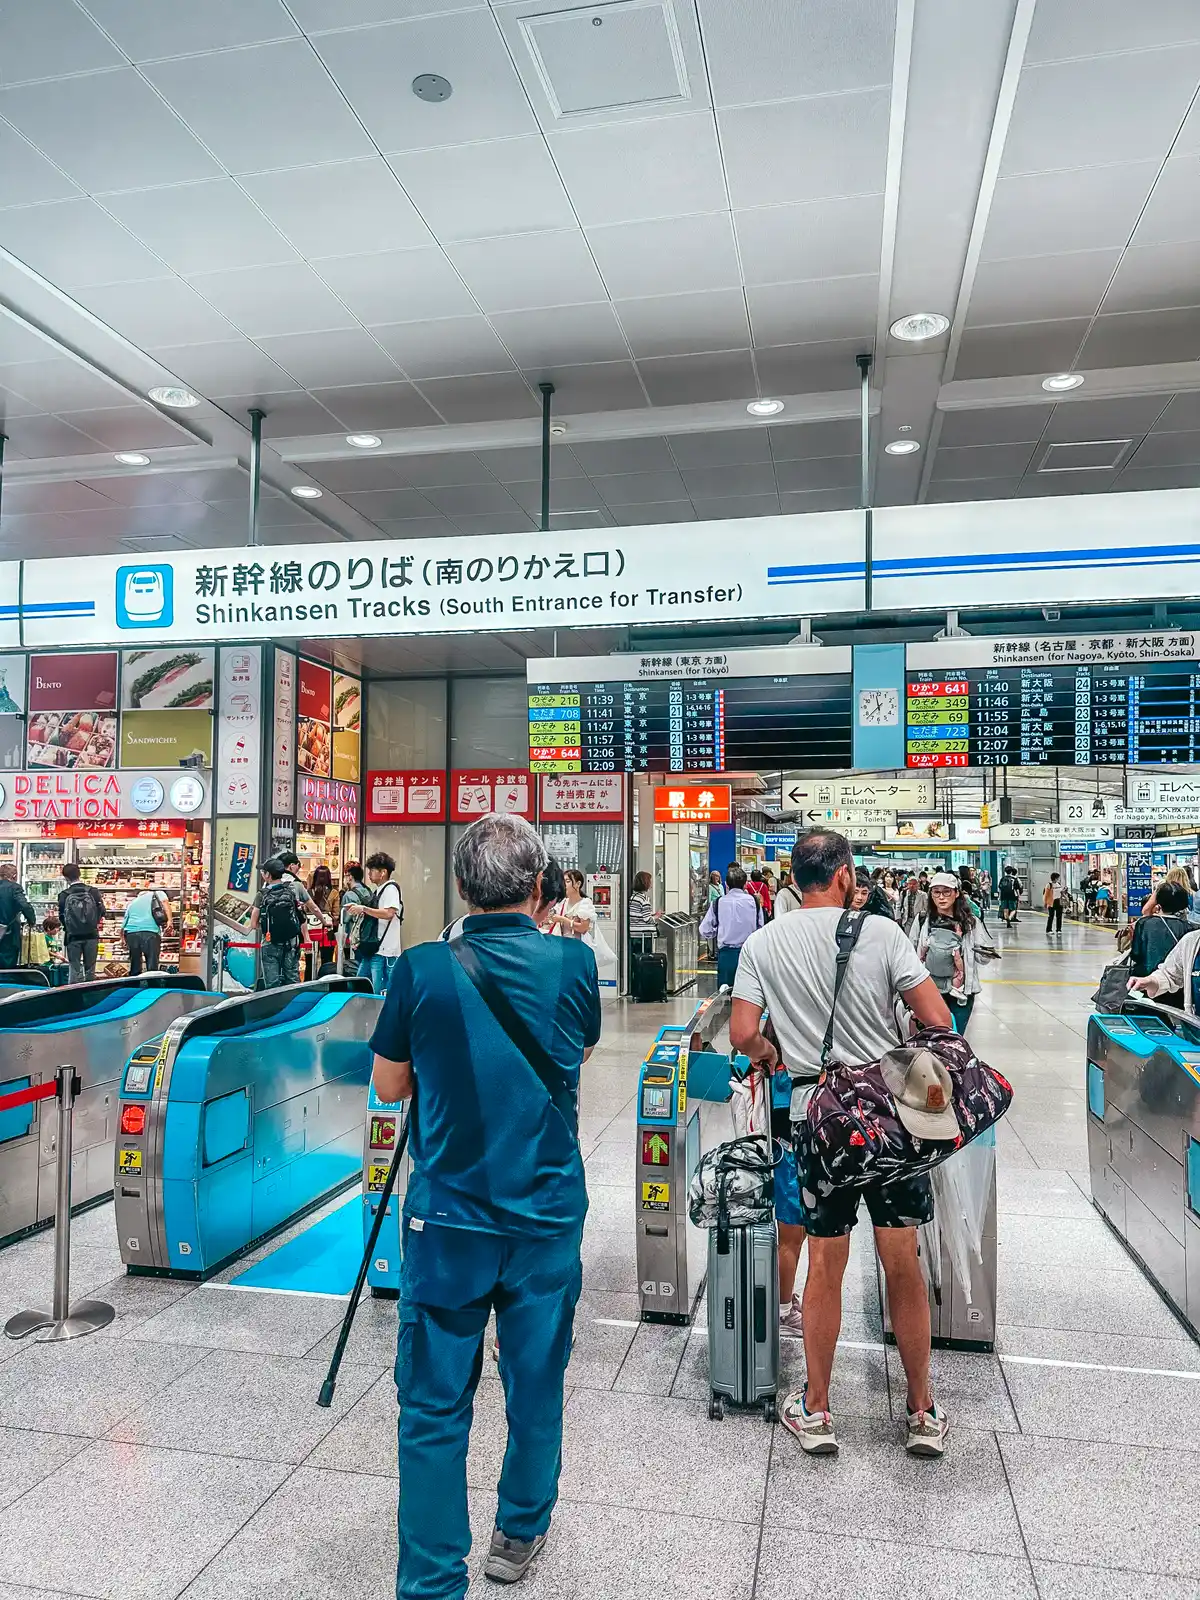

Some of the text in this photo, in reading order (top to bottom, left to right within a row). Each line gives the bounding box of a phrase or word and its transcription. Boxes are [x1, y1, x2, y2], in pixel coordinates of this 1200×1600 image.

[196, 584, 743, 624] Shinkansen Tracks (South Entrance for Transfer)
[993, 654, 1044, 663] Shinkansen
[1048, 653, 1065, 662] (for
[1067, 651, 1104, 662] Nagoya,
[1107, 649, 1137, 660] Kyōto,
[639, 668, 683, 677] Shinkansen
[685, 667, 700, 675] (for
[912, 684, 939, 692] ひかり
[945, 683, 966, 694] 641
[977, 682, 1009, 693] 11:40
[1076, 679, 1089, 690] 24
[532, 696, 556, 704] のぞみ
[560, 696, 579, 705] 216
[586, 695, 614, 705] 11:39
[670, 693, 682, 703] 22
[945, 698, 967, 709] 349
[977, 697, 1009, 707] 11:46
[1076, 694, 1089, 705] 23
[560, 709, 579, 718] 708
[587, 708, 613, 718] 11:41
[671, 706, 682, 716] 21
[948, 712, 963, 722] 69
[977, 711, 1009, 722] 11:55
[1076, 709, 1089, 719] 23
[563, 723, 576, 732] 84
[587, 722, 614, 731] 11:47
[671, 720, 682, 730] 21
[912, 727, 939, 735] こだま
[945, 727, 967, 737] 723
[977, 725, 1009, 736] 12:04
[1076, 724, 1089, 734] 24
[563, 736, 576, 745] 86
[587, 735, 614, 744] 11:57
[671, 733, 682, 743] 21
[912, 741, 939, 749] のぞみ
[945, 741, 967, 751] 227
[977, 740, 1009, 751] 12:07
[1076, 738, 1089, 749] 23
[533, 748, 556, 756] ひかり
[560, 748, 580, 758] 644
[587, 748, 615, 757] 12:06
[671, 746, 682, 756] 21
[912, 755, 939, 763] ひかり
[945, 755, 966, 765] 511
[977, 754, 1009, 765] 12:10
[1076, 753, 1089, 763] 24
[567, 762, 574, 771] 6
[588, 761, 615, 771] 12:09
[671, 760, 683, 770] 22
[373, 774, 527, 786] お弁当 サンド ビール お飲物
[556, 789, 609, 800] 弁当売店 が
[840, 785, 926, 796] エレベーター 21
[841, 796, 927, 805] Elevator 22
[1160, 794, 1200, 802] Elevator
[555, 801, 610, 810] ございません。
[1068, 805, 1106, 818] 23 24
[672, 810, 711, 819] Ekiben
[1126, 813, 1156, 821] Nagoya,
[77, 821, 171, 831] サンドイッチ お弁当
[844, 829, 868, 838] 21 22
[1010, 828, 1020, 837] 23
[1025, 828, 1036, 836] 24
[645, 1284, 671, 1293] 4 3
